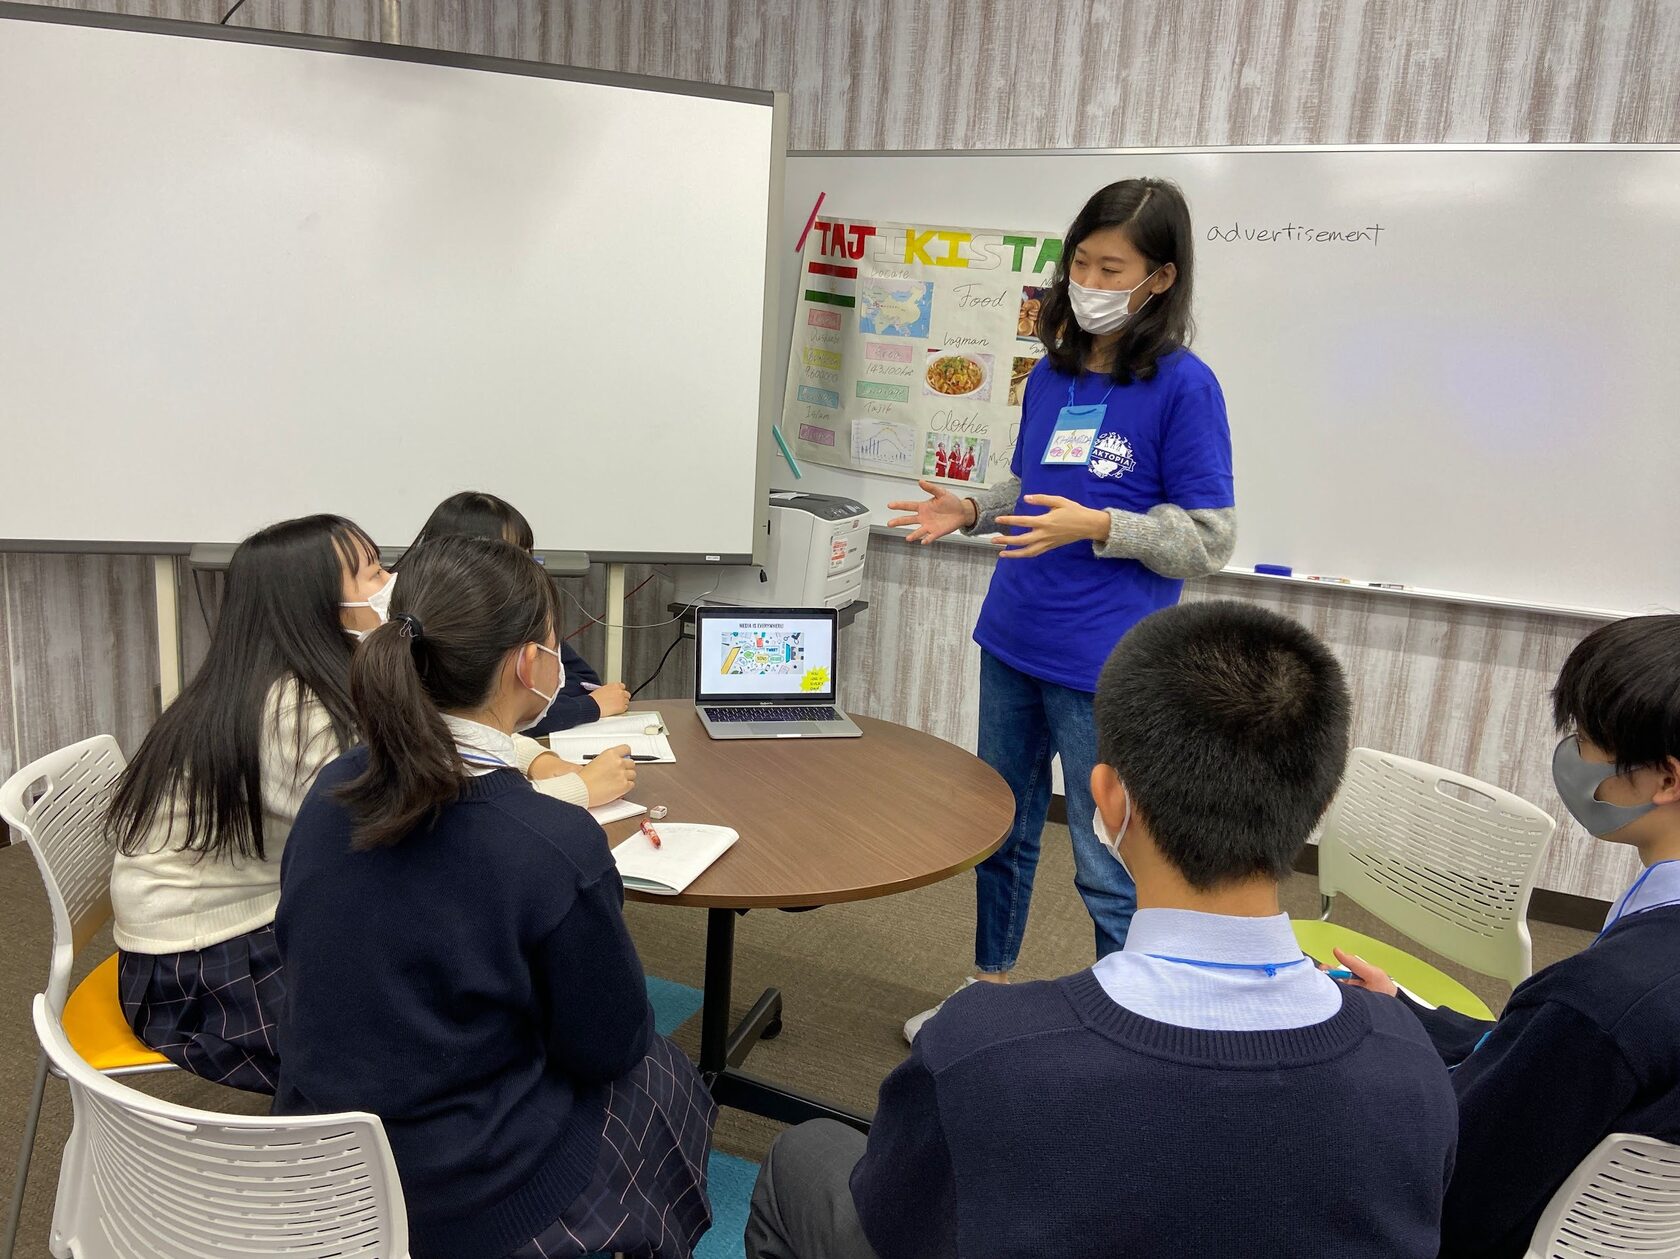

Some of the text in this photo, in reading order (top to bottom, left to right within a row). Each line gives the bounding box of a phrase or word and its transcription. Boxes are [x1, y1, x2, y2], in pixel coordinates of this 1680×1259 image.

[1206, 221, 1385, 247] advertisement
[813, 221, 1063, 274] TAJIKISTA
[953, 282, 1008, 308] Food
[930, 410, 990, 435] Clothes
[1091, 448, 1131, 467] AKTOPIA
